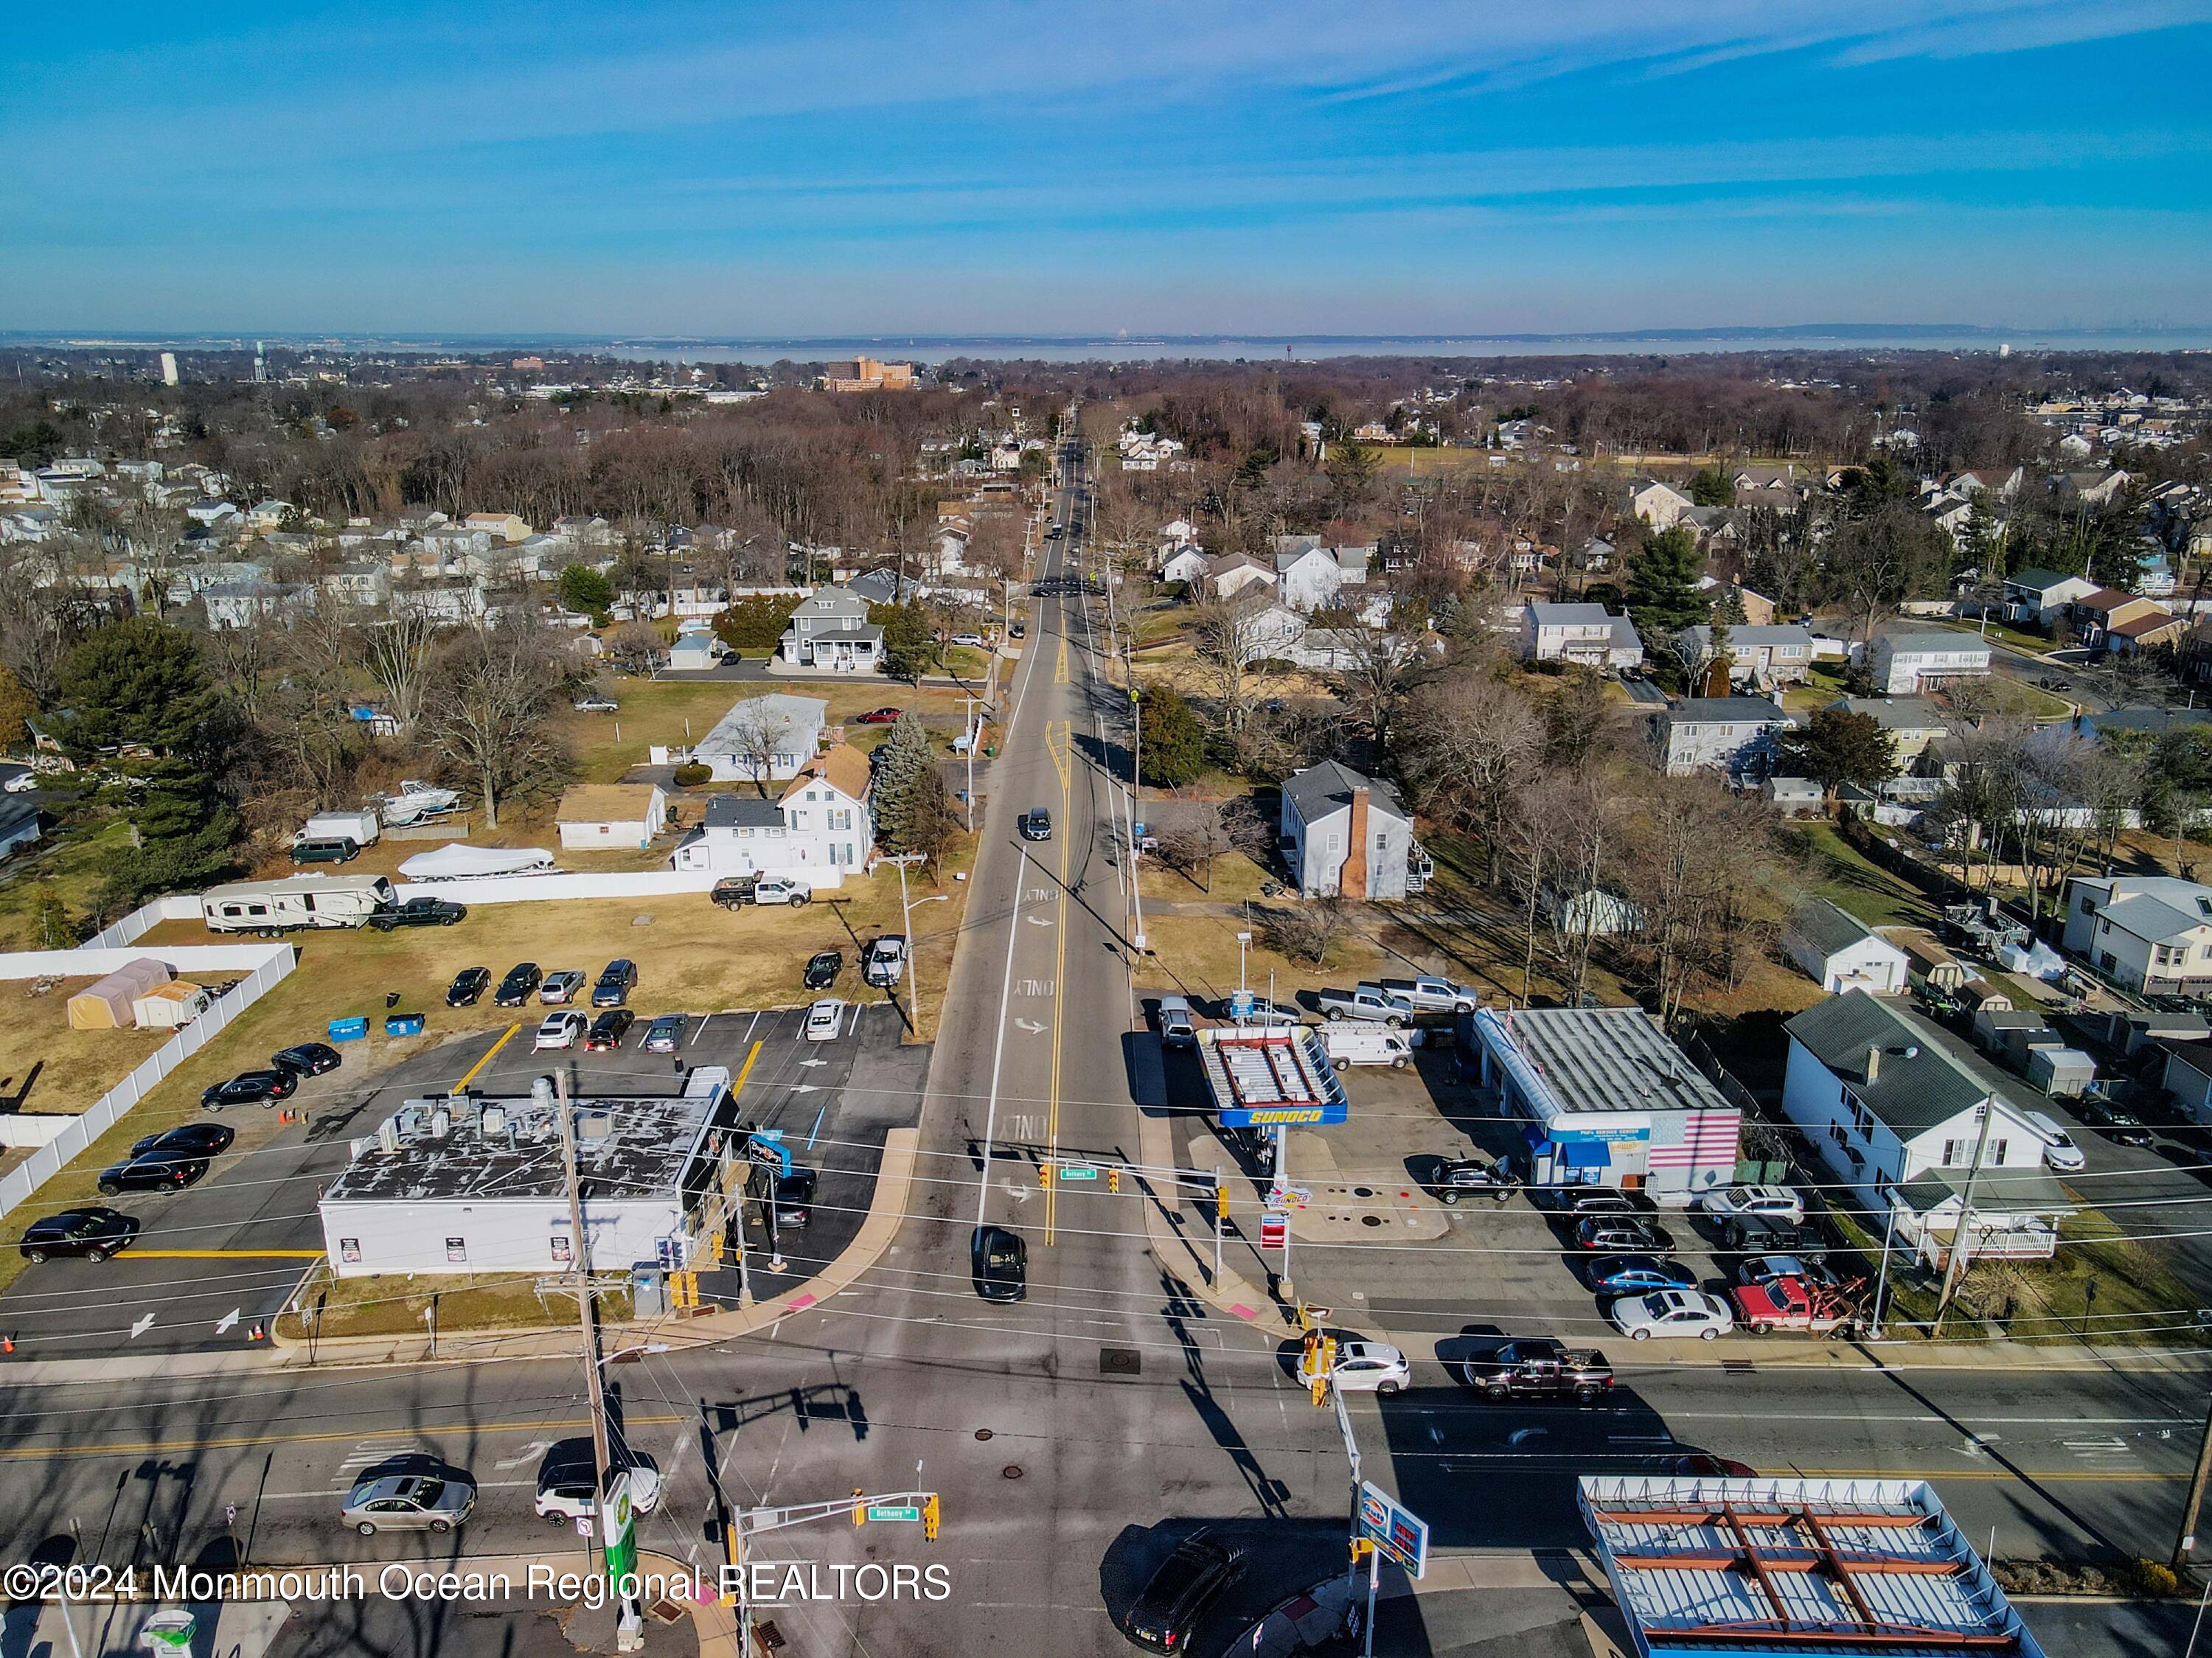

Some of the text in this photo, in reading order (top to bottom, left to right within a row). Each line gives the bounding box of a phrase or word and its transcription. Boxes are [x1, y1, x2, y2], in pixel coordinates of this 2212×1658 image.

[1023, 888, 1059, 902] ONLY
[1013, 979, 1054, 997] ONLY
[1249, 1110, 1324, 1124] SUNOCO
[1276, 1194, 1309, 1204] SUNOCO
[877, 1509, 902, 1519] Bethany
